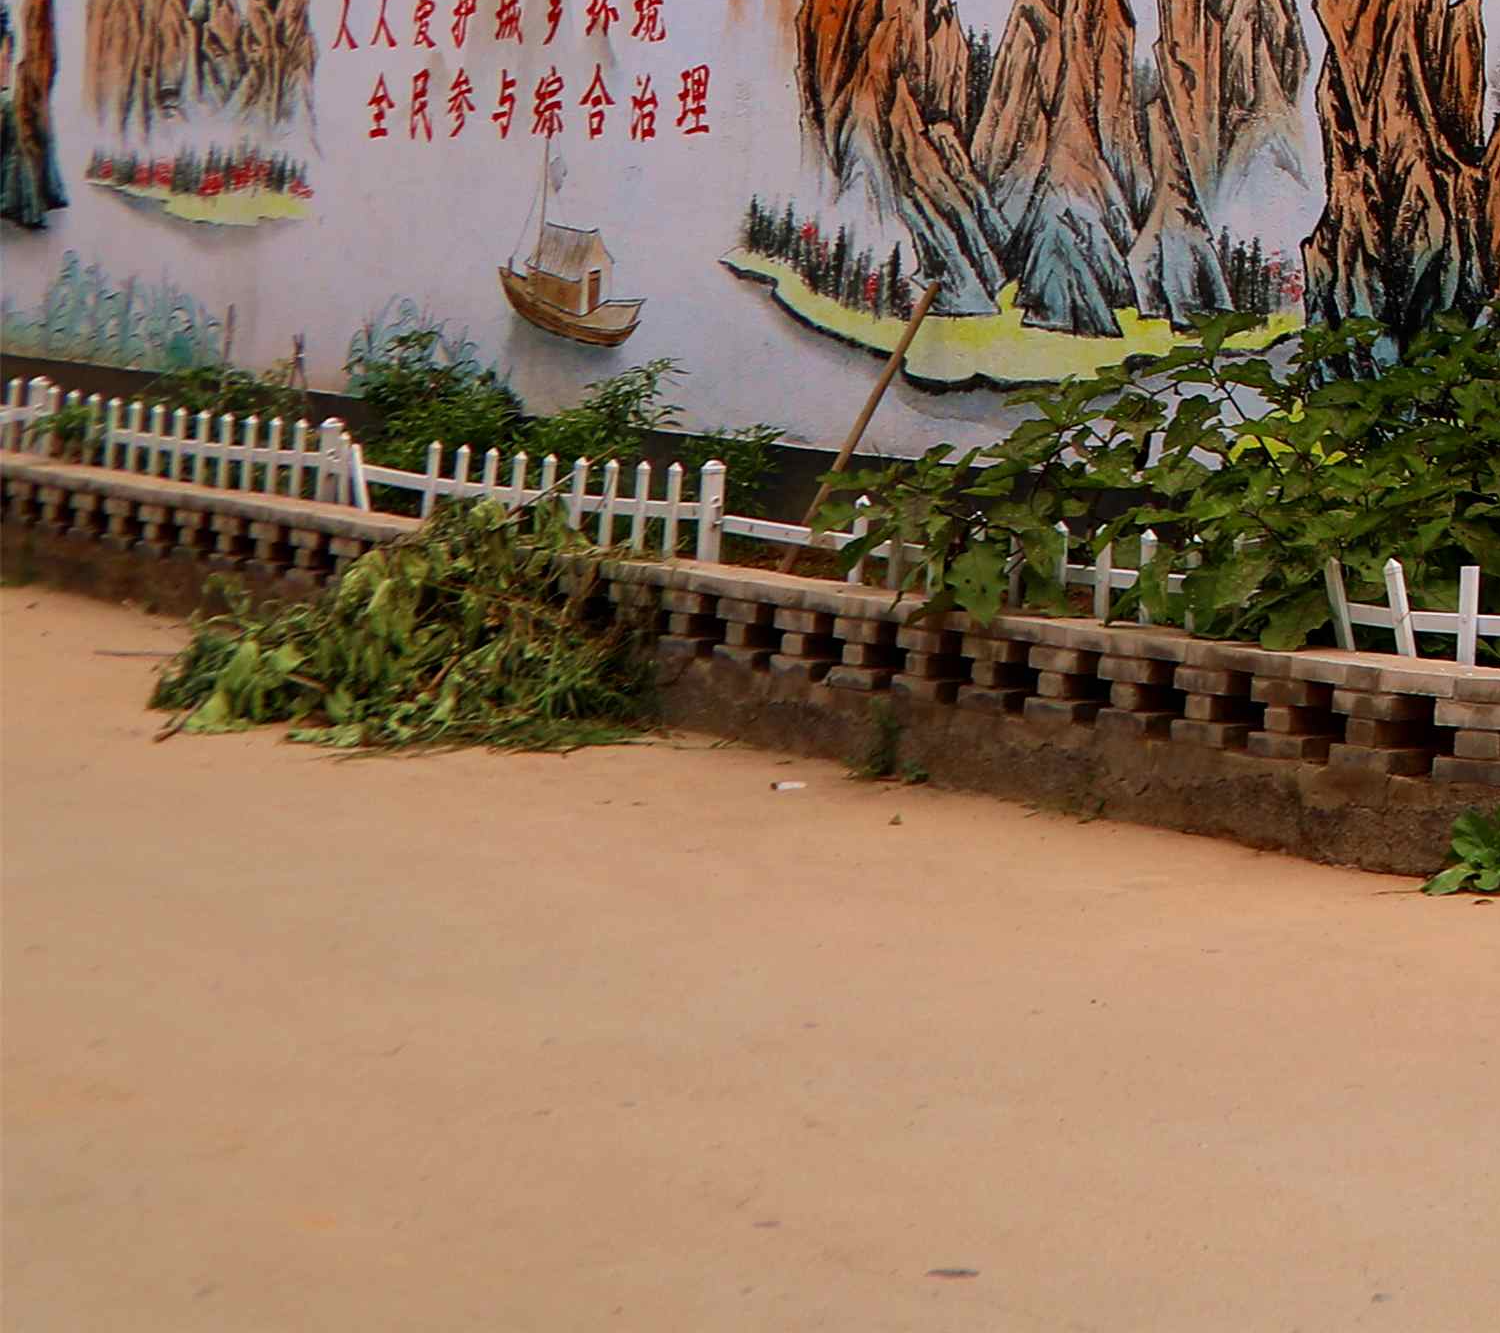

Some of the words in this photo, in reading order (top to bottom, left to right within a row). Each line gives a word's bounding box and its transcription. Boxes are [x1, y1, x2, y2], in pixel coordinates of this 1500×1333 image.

[367, 63, 711, 143] 全民参与综合治理
